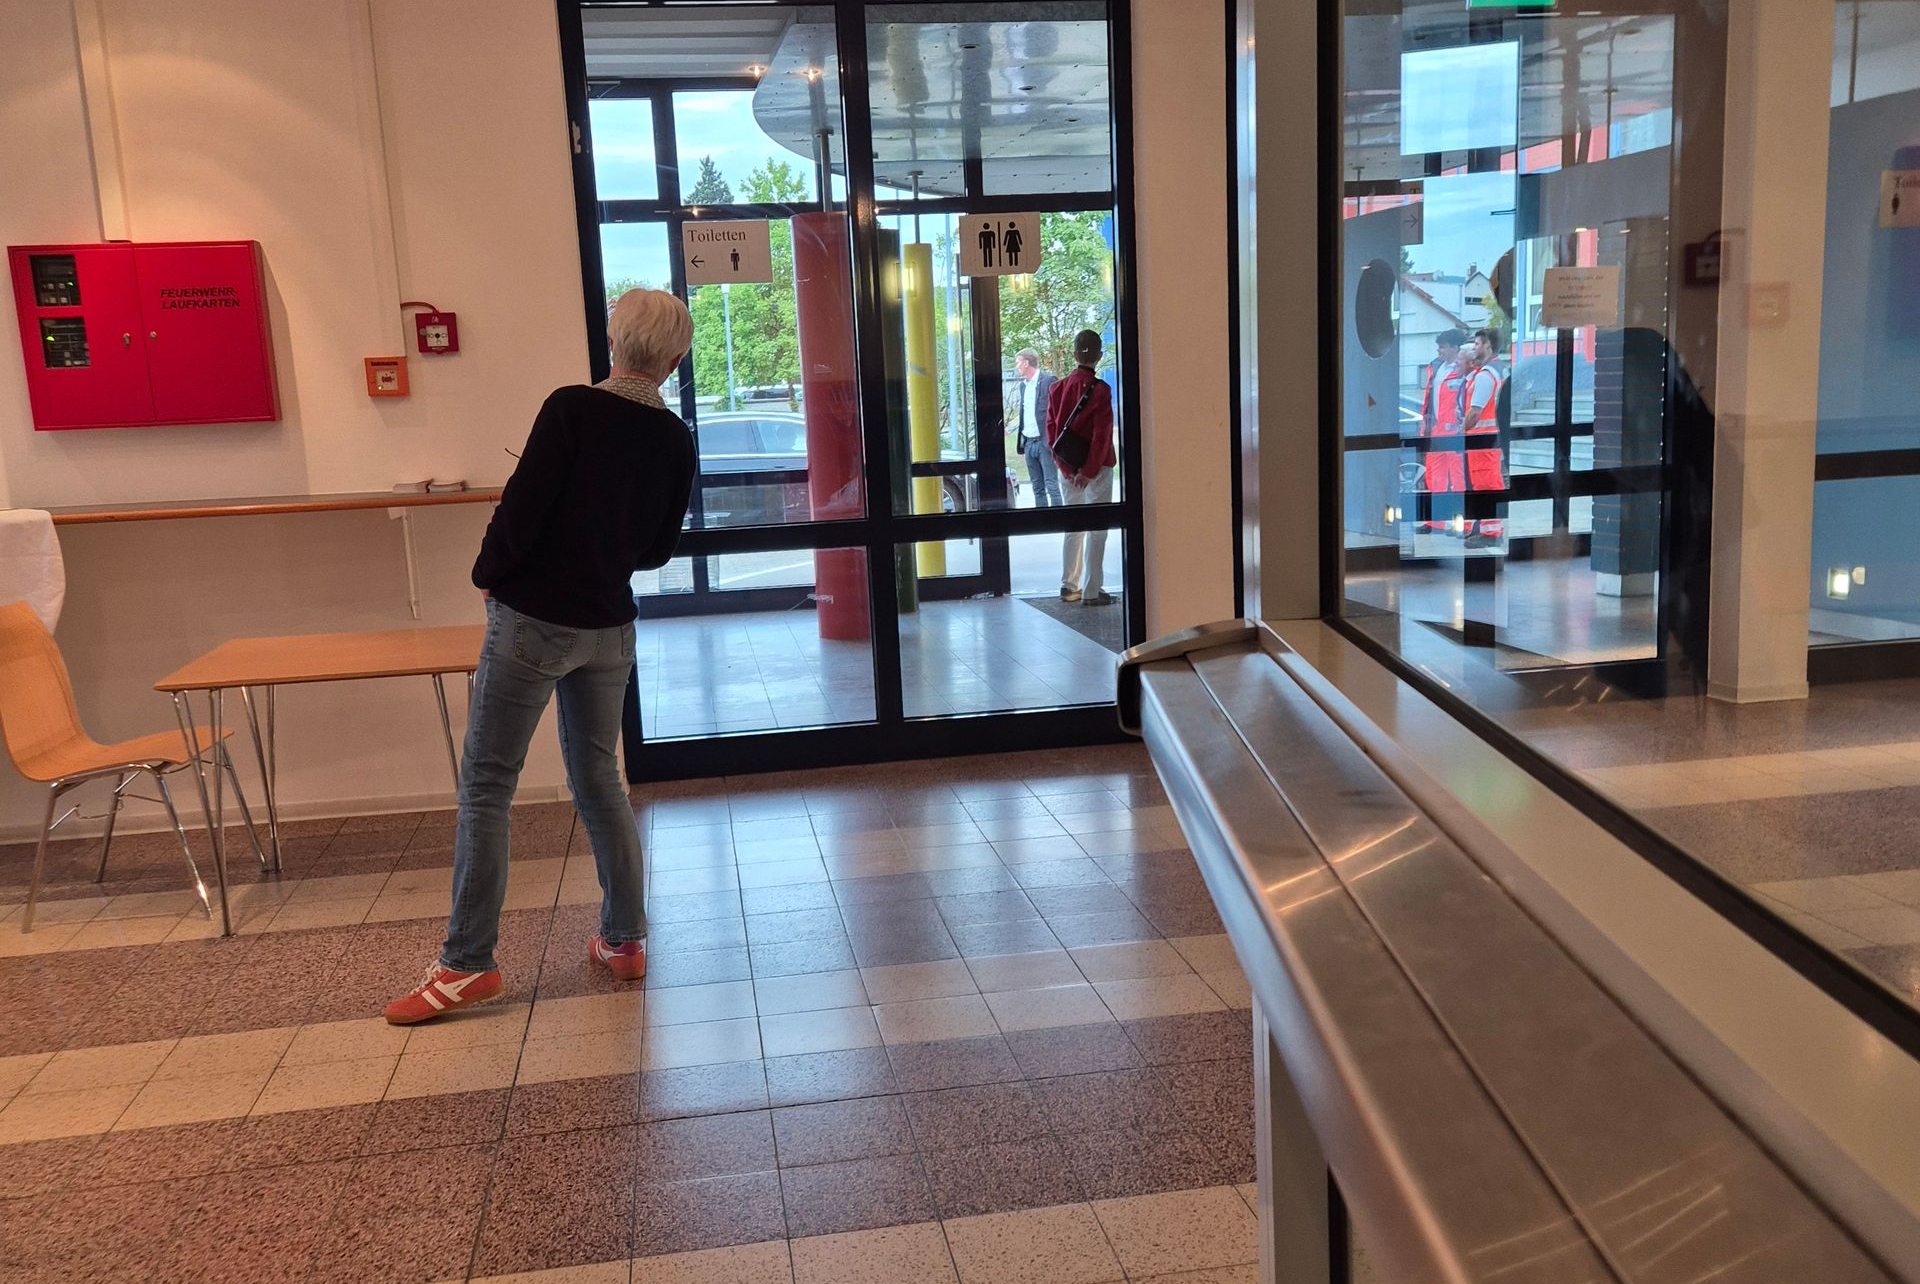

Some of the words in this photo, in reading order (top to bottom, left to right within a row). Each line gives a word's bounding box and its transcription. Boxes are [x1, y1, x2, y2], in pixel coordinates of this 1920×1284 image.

[687, 228, 746, 242] Toiletten
[160, 286, 238, 298] FEUERWEHR-
[161, 298, 240, 310] LAUFKARTEN
